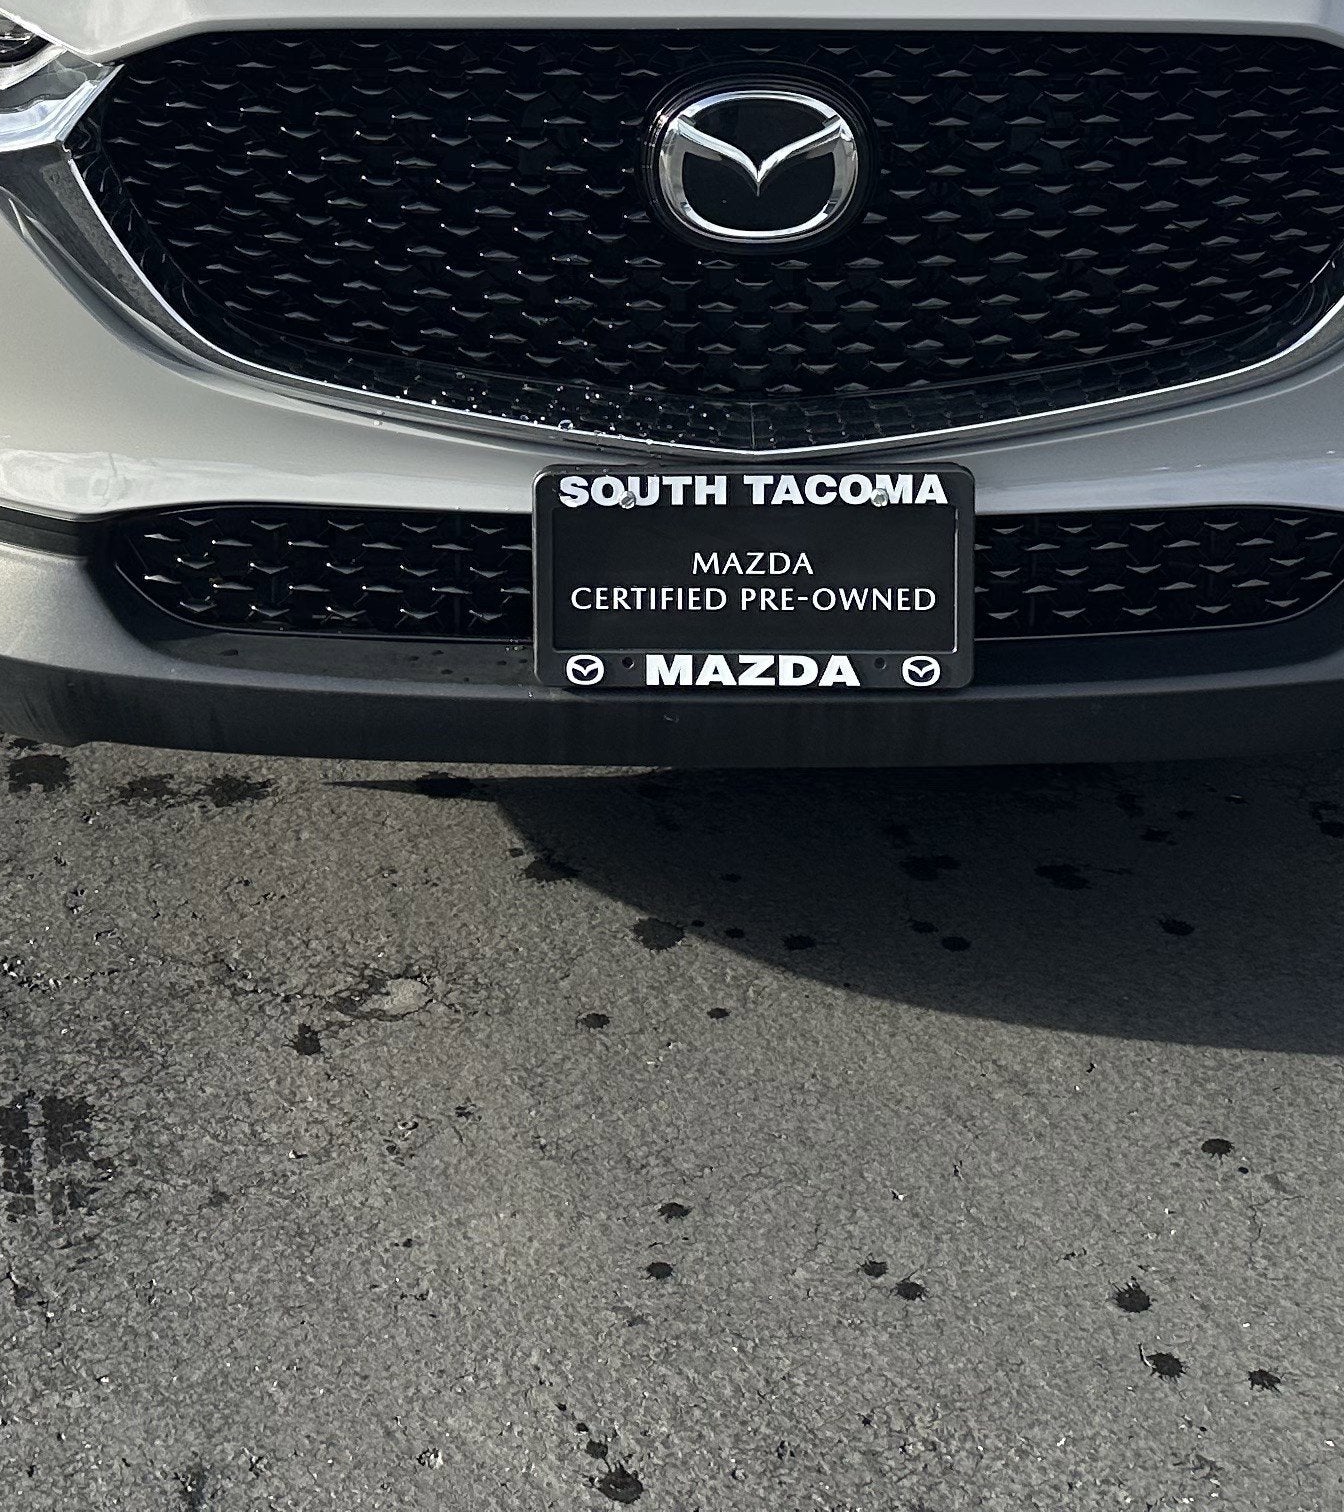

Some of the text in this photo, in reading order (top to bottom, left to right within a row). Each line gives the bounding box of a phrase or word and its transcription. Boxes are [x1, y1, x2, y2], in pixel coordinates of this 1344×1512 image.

[559, 473, 948, 508] SOUTH TACOMA
[692, 551, 814, 575] MAZDA
[570, 586, 937, 611] CERTIFIED PRE-OWNED
[645, 653, 861, 687] MAZDA
